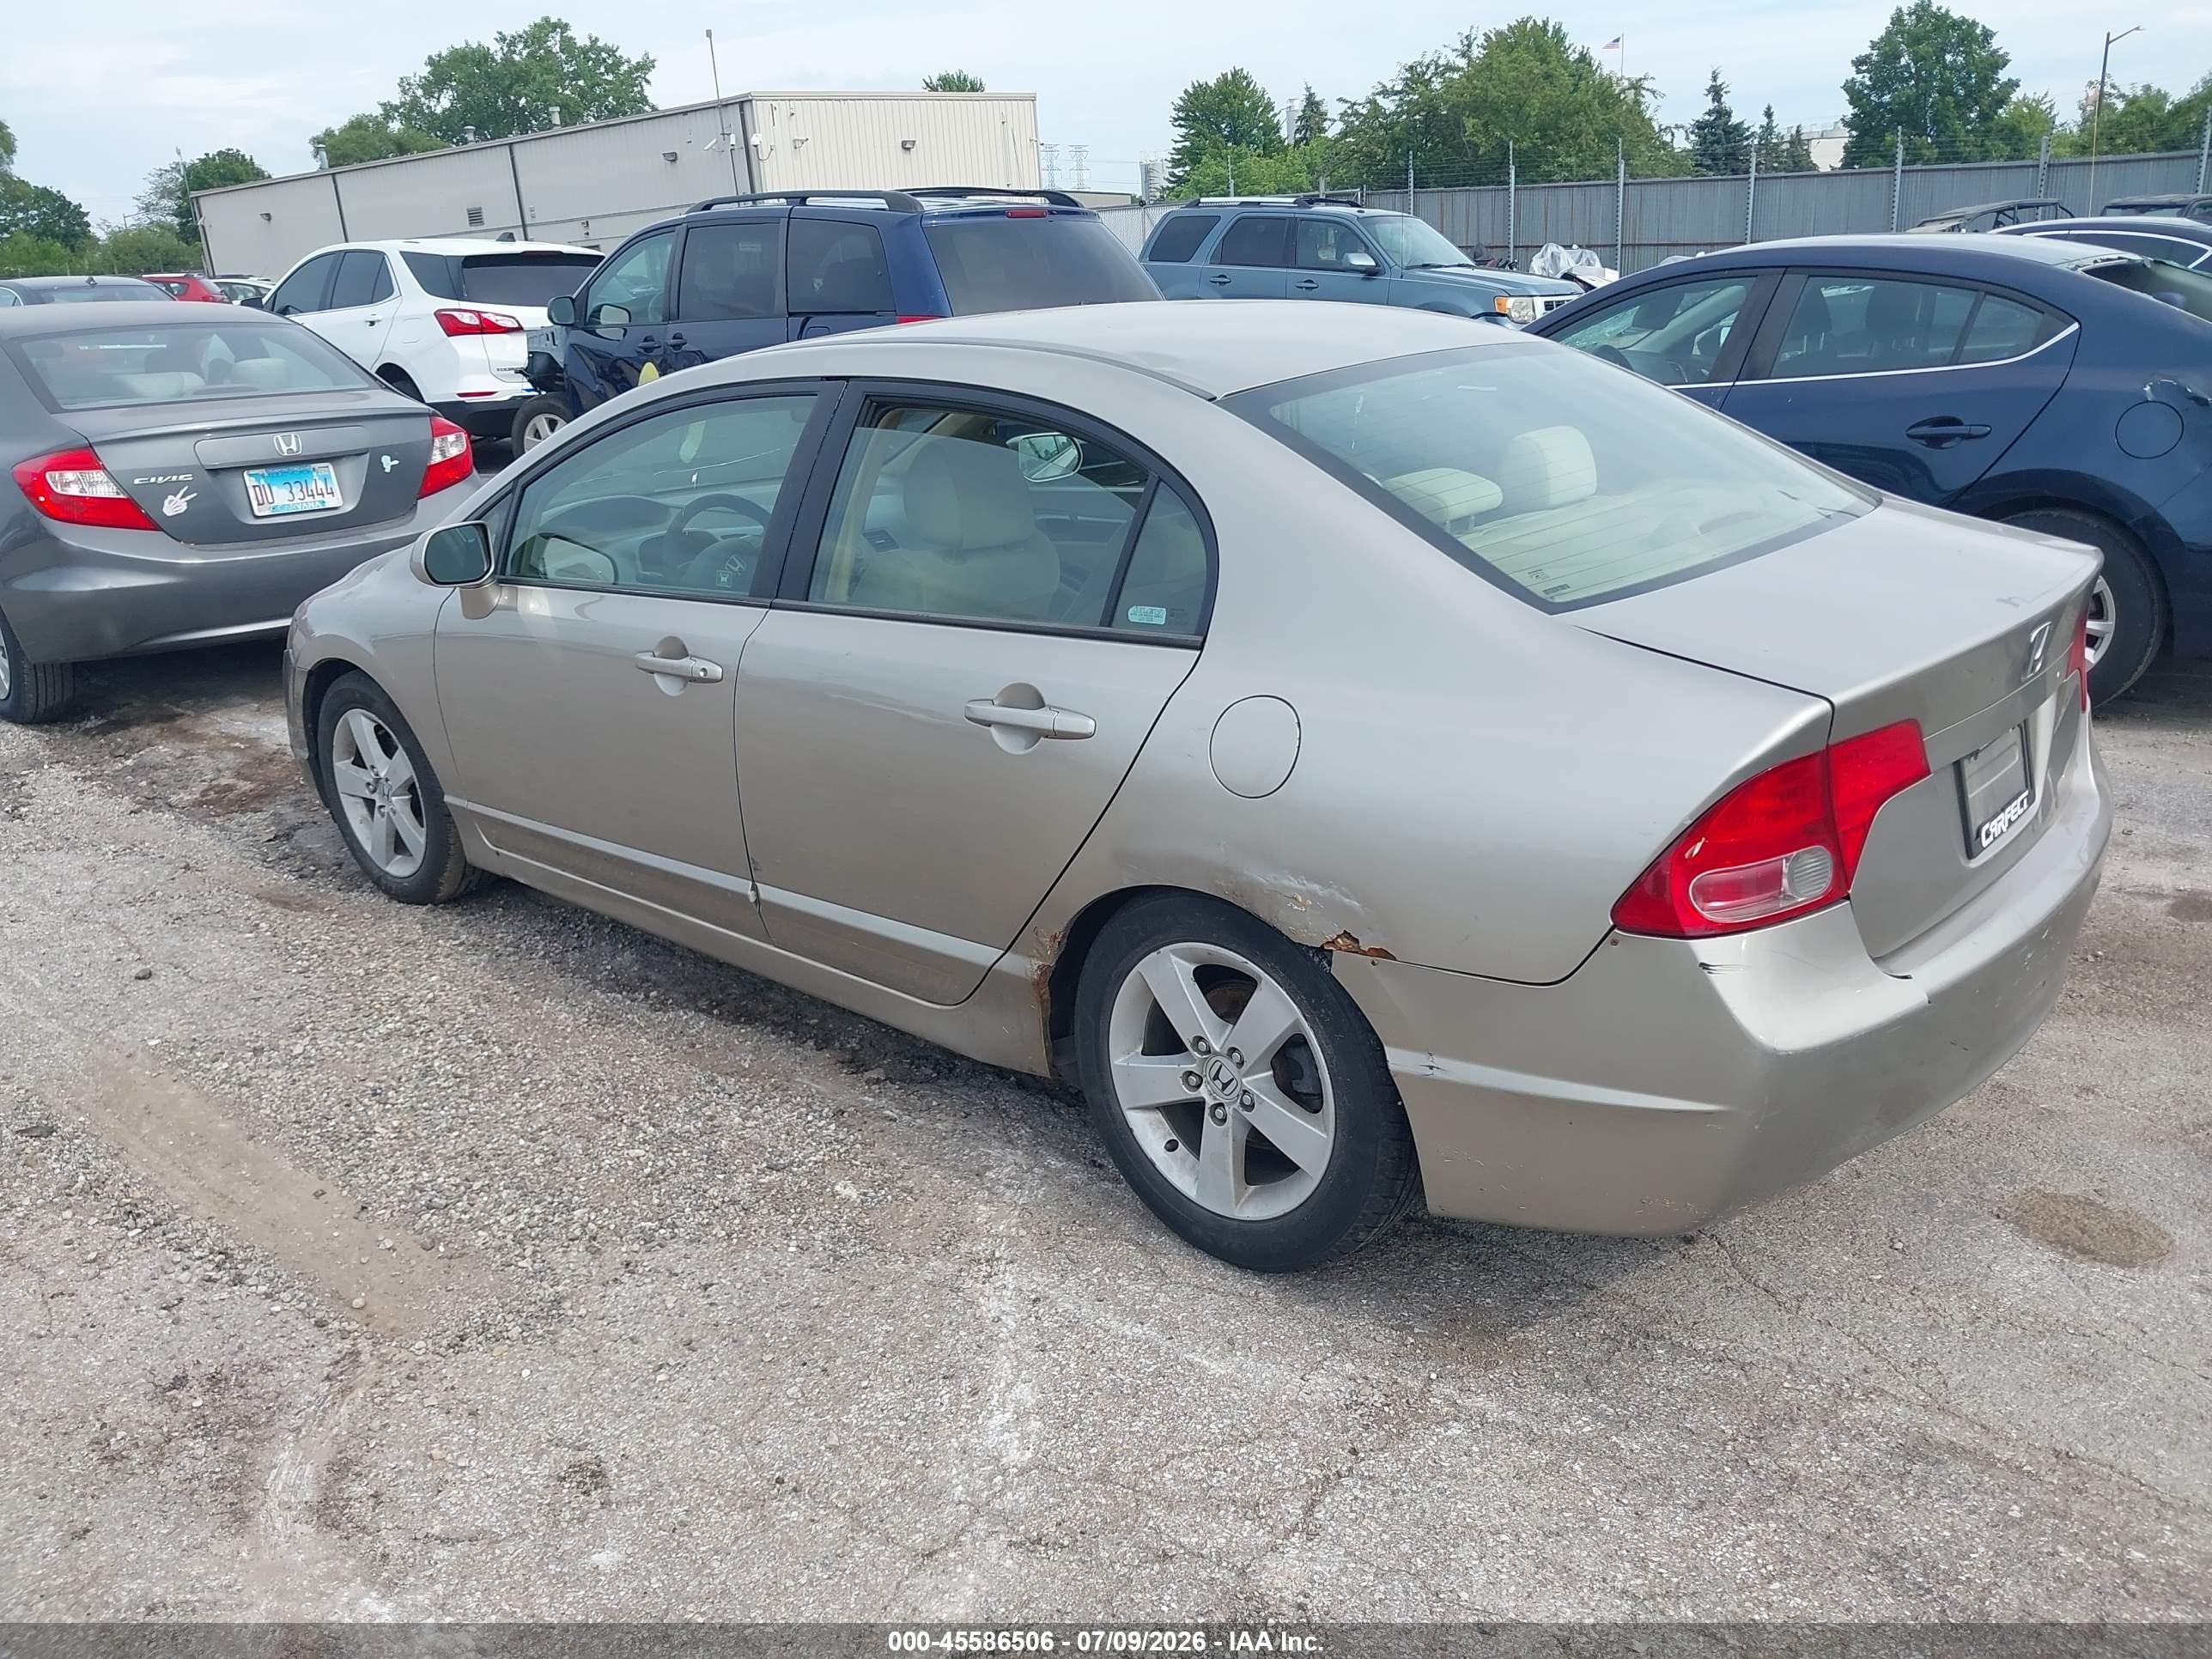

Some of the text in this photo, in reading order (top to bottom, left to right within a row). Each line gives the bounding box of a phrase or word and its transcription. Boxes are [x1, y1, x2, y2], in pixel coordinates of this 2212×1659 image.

[133, 474, 193, 484] CIVIC
[252, 477, 334, 506] DU 33444
[1981, 790, 2028, 848] CARFECT
